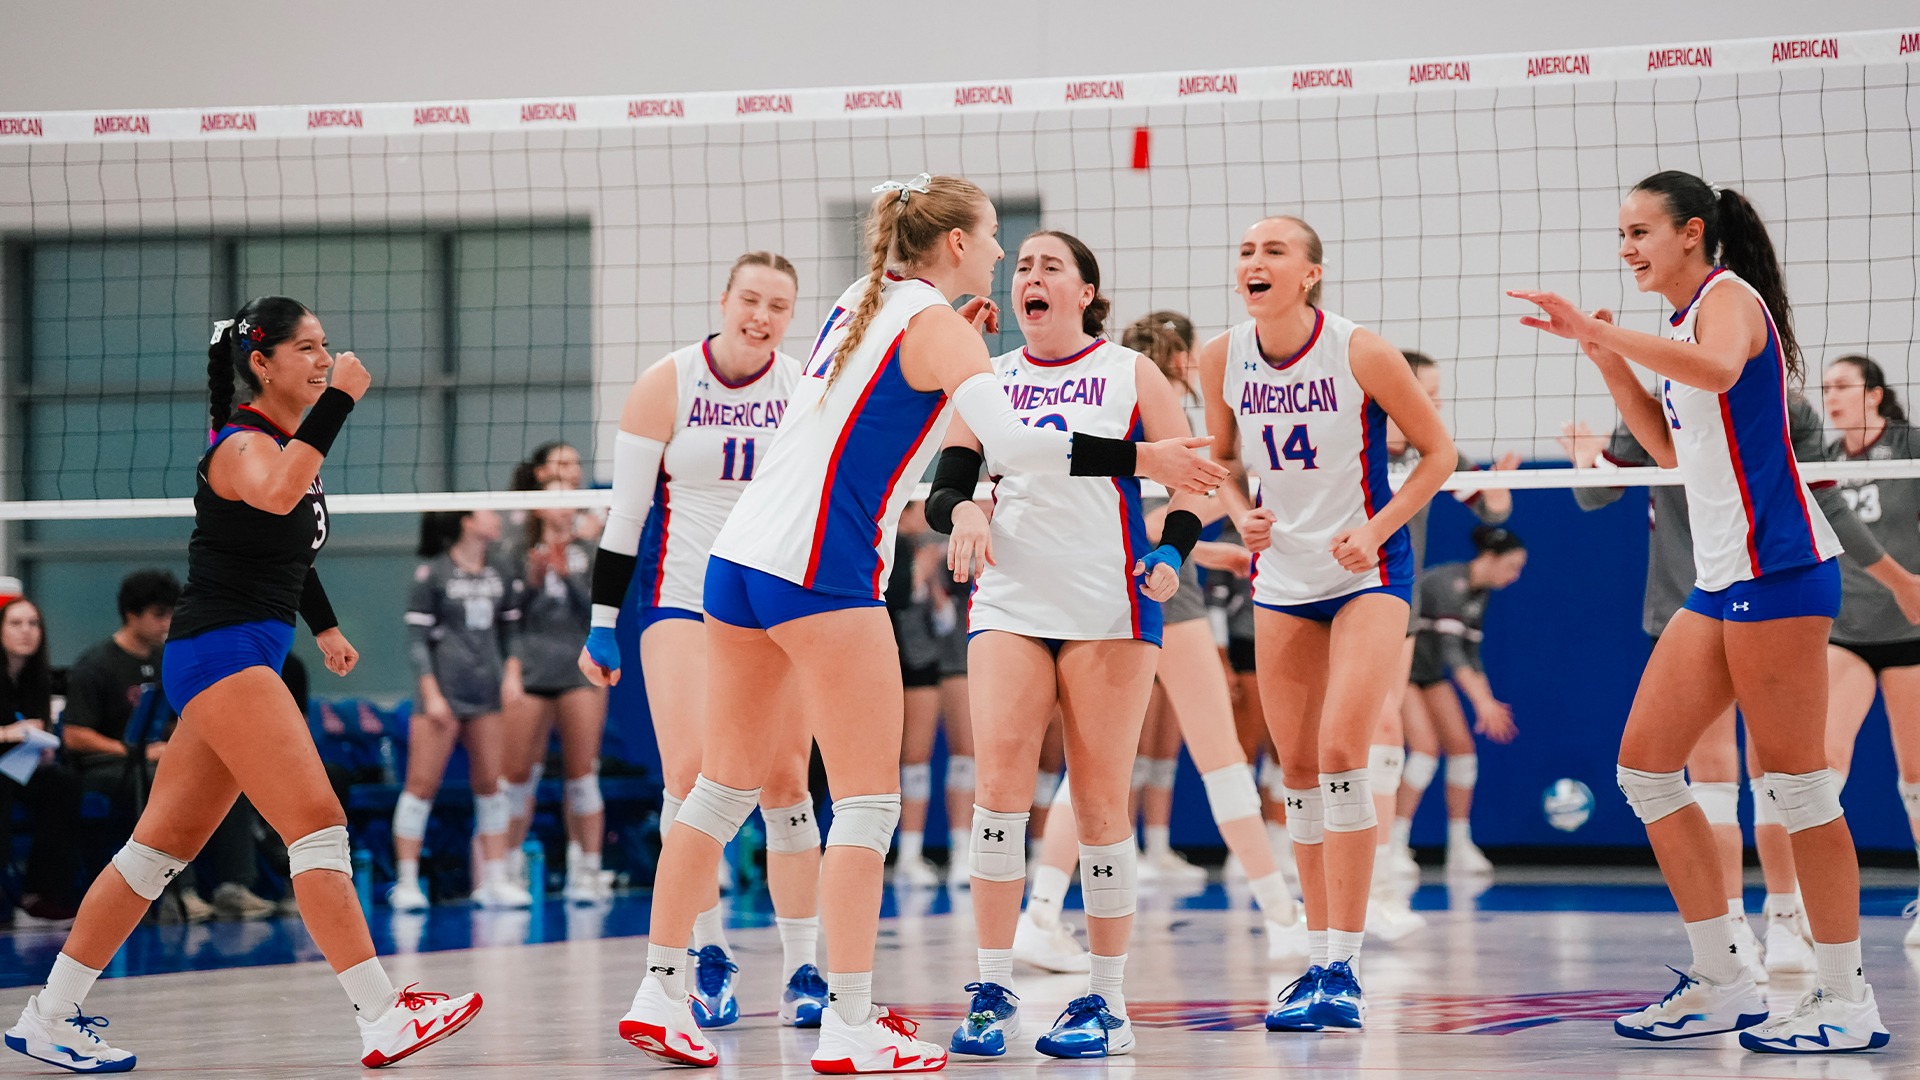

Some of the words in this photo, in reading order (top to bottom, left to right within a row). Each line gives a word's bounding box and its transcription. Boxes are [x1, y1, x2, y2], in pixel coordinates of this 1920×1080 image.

[94, 116, 150, 135] AMERICAN
[201, 113, 257, 131] AMERICAN
[308, 111, 363, 128] AMERICAN
[415, 107, 470, 125] AMERICAN
[521, 103, 577, 121] AMERICAN
[628, 100, 684, 117] AMERICAN
[736, 96, 793, 114] AMERICAN
[845, 92, 902, 110] AMERICAN
[955, 87, 1013, 105] AMERICAN
[1065, 81, 1124, 100] AMERICAN
[1179, 76, 1238, 95] AMERICAN
[1292, 69, 1352, 89] AMERICAN
[1409, 62, 1470, 83] AMERICAN
[1527, 55, 1591, 77] AMERICAN
[1648, 47, 1712, 70] AMERICAN
[1772, 39, 1839, 63] AMERICAN
[1240, 377, 1338, 416] AMERICAN
[719, 437, 756, 481] 11
[1262, 424, 1319, 471] 14
[311, 501, 327, 550] 3
